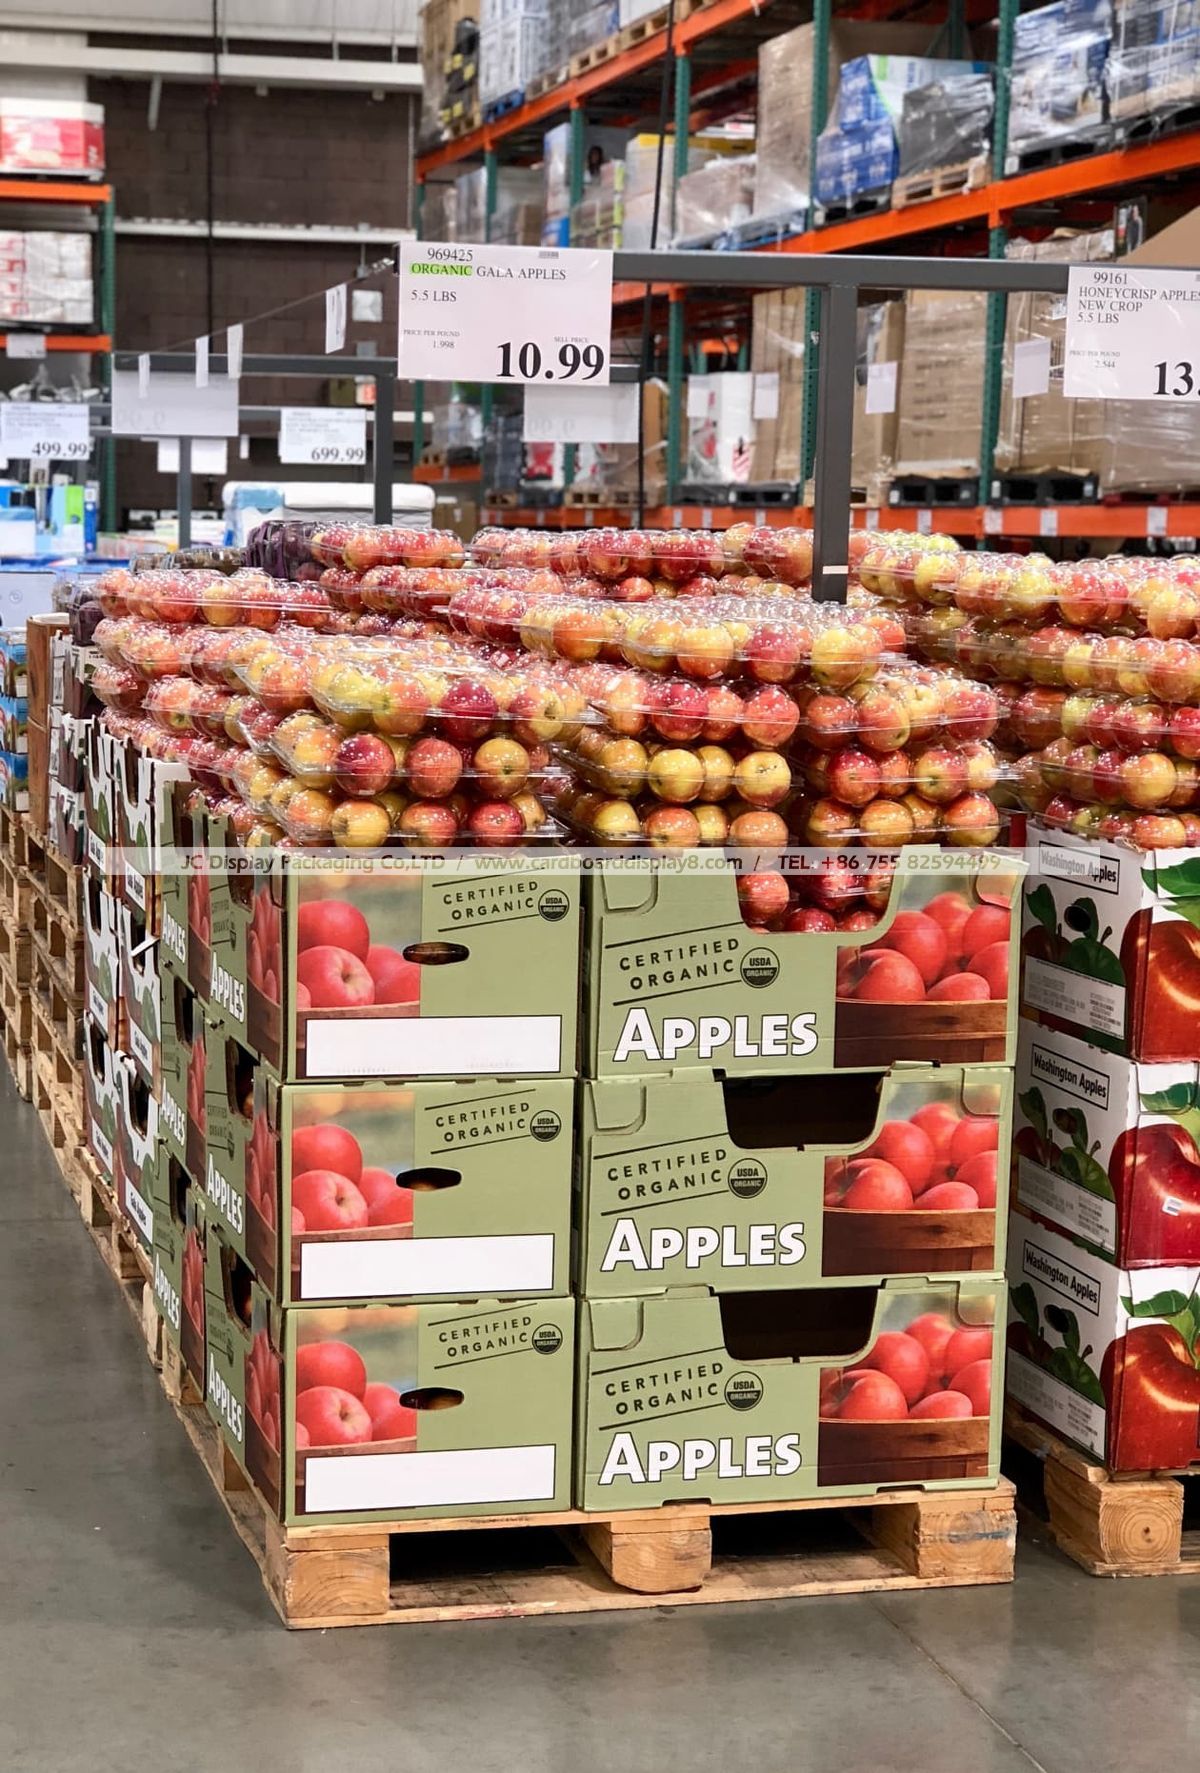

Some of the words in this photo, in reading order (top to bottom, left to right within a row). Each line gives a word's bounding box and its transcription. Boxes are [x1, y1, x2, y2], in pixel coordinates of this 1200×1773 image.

[427, 247, 473, 262] 969425
[411, 263, 473, 276] ORGANIC
[476, 266, 513, 278] GALA
[518, 269, 566, 280] APPLES
[1094, 272, 1127, 285] 99161
[411, 290, 429, 301] 5.5
[433, 291, 457, 302] LBS
[1079, 286, 1157, 299] HONEYCRISP
[1078, 312, 1094, 323] 5.5
[1098, 313, 1119, 323] LBS
[1079, 300, 1106, 310] NEW
[1110, 302, 1143, 312] CROP
[497, 342, 605, 380] 10.99
[1153, 361, 1200, 396] 13
[32, 442, 88, 457] 499.99
[311, 447, 364, 462] 699.99
[1087, 861, 1117, 883] Apples
[443, 881, 538, 905] CERTIFIED
[451, 897, 534, 920] ORGANIC
[619, 938, 740, 971] CERTIFIED
[630, 959, 735, 990] ORGANIC
[1033, 1052, 1077, 1084] Washington
[1079, 1072, 1107, 1100] Apples
[435, 1102, 530, 1128] CERTIFIED
[444, 1118, 526, 1142] ORGANIC
[607, 1149, 727, 1181] CERTIFIED
[618, 1169, 722, 1200] ORGANIC
[1025, 1249, 1069, 1283] Washington
[1070, 1275, 1098, 1304] Apples
[439, 1316, 532, 1343] CERTIFIED
[447, 1332, 528, 1357] ORGANIC
[605, 1362, 724, 1396] CERTIFIED
[616, 1383, 719, 1415] ORGANIC
